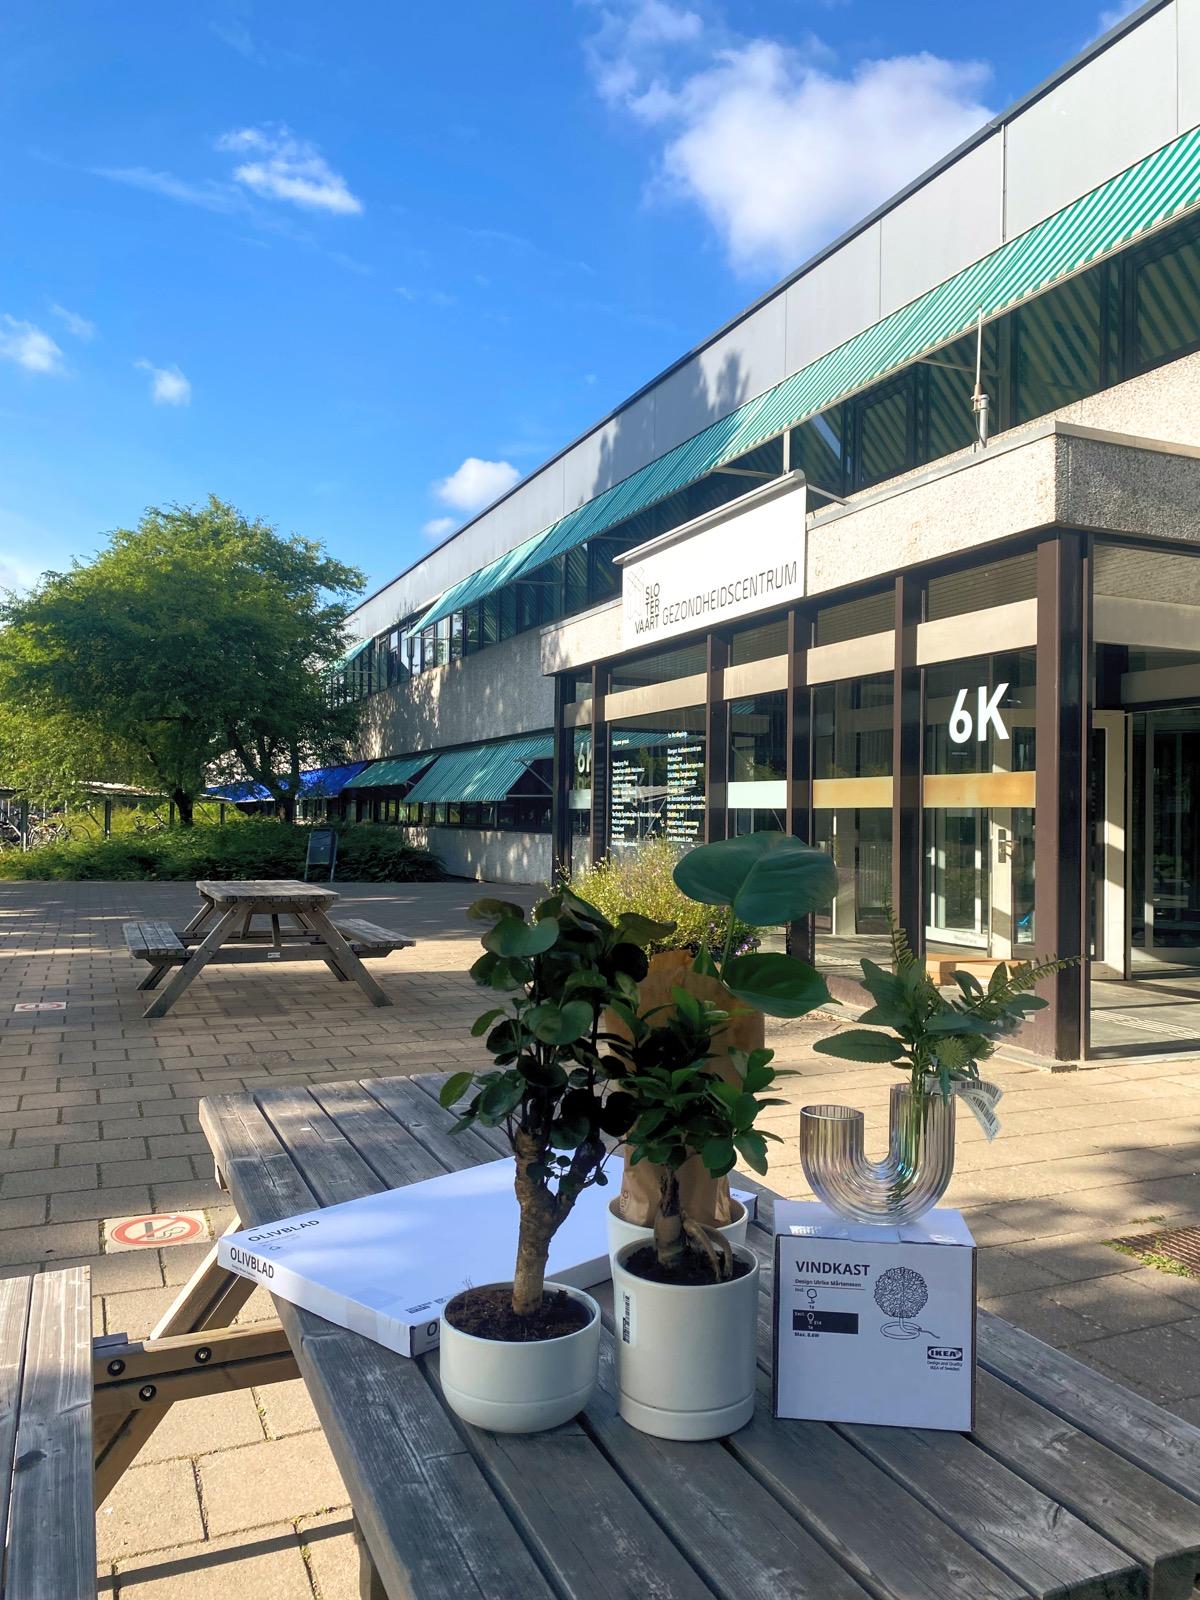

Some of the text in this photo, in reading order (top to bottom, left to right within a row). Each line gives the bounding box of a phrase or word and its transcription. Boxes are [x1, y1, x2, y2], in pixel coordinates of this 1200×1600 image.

[645, 583, 660, 600] SLO
[662, 561, 797, 626] GEZONDHEIDSCENTRUM
[645, 599, 660, 615] TER
[635, 614, 660, 634] VAART
[949, 682, 1010, 744] 6K
[248, 1220, 320, 1242] OLIVBLAD
[230, 1247, 275, 1279] OLIVBLAD
[795, 1260, 870, 1276] VINDKAST
